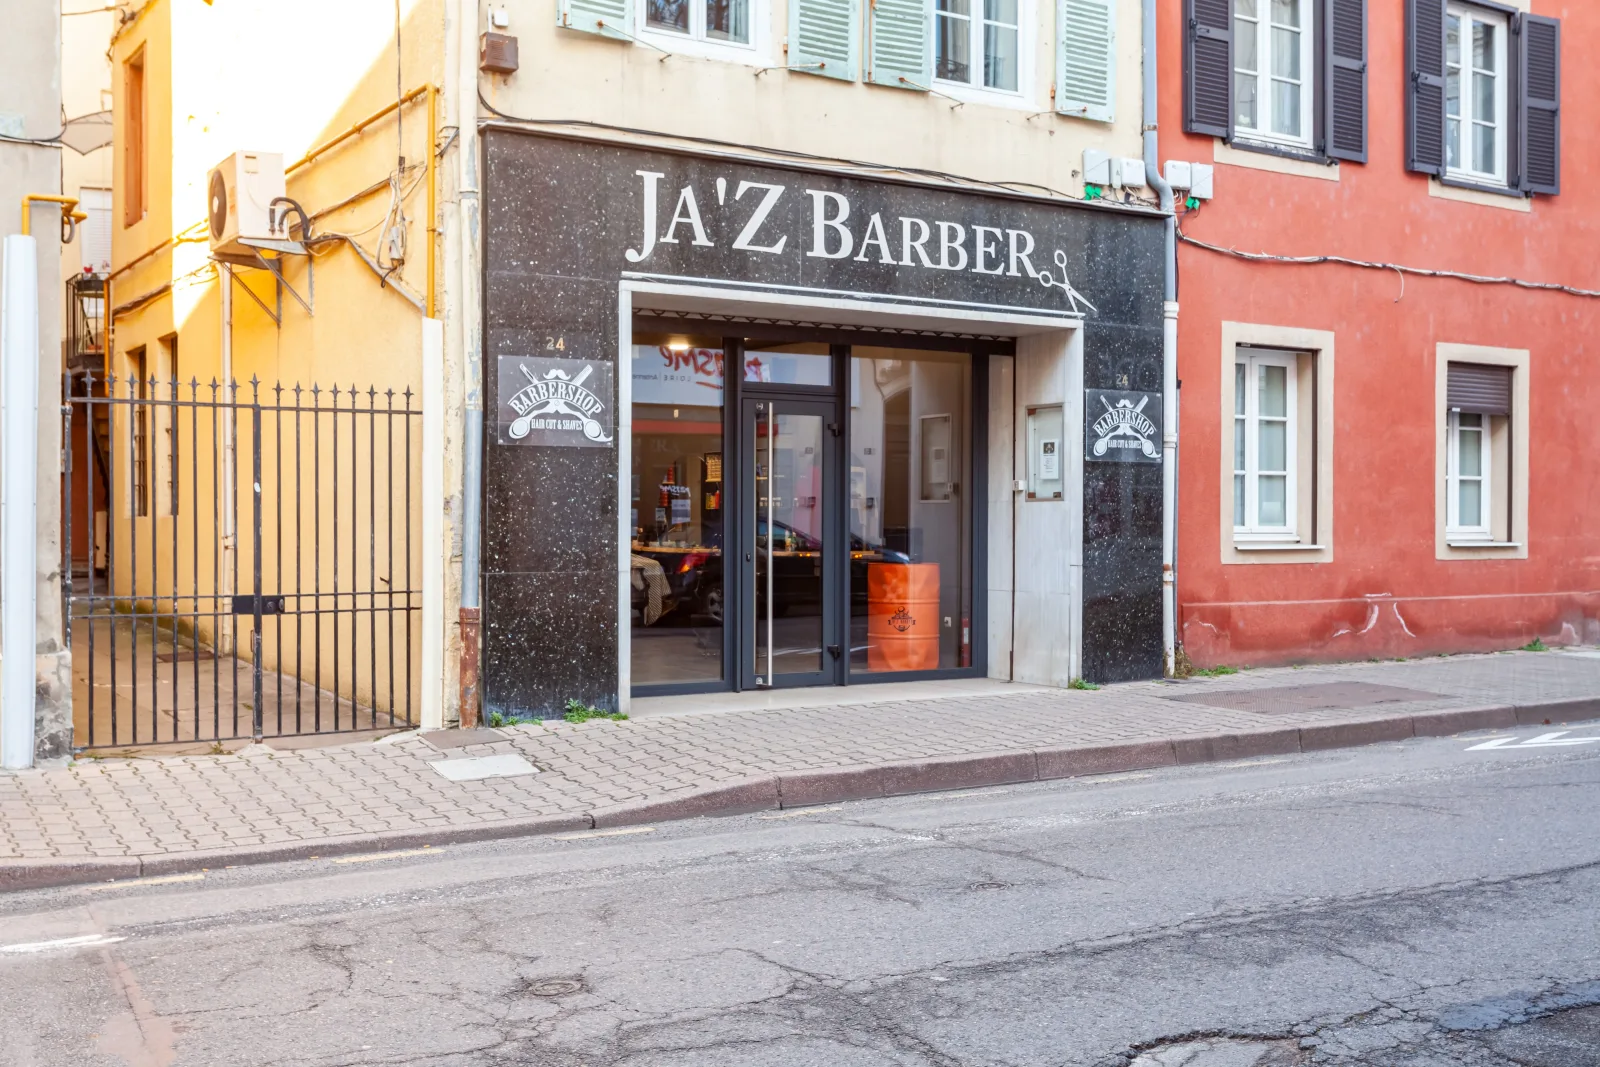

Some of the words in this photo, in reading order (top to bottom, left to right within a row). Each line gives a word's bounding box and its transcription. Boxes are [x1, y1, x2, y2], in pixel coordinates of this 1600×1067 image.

[625, 169, 788, 263] JA'Z
[806, 188, 1042, 278] BARBER
[546, 336, 565, 351] 24
[1115, 373, 1129, 386] 24
[509, 381, 602, 416] BARBERSHOP
[531, 418, 545, 429] HAIR
[546, 419, 556, 430] CUT
[557, 419, 562, 430] &
[563, 419, 583, 431] SHAVES
[1093, 409, 1155, 437] BARBERSHOP
